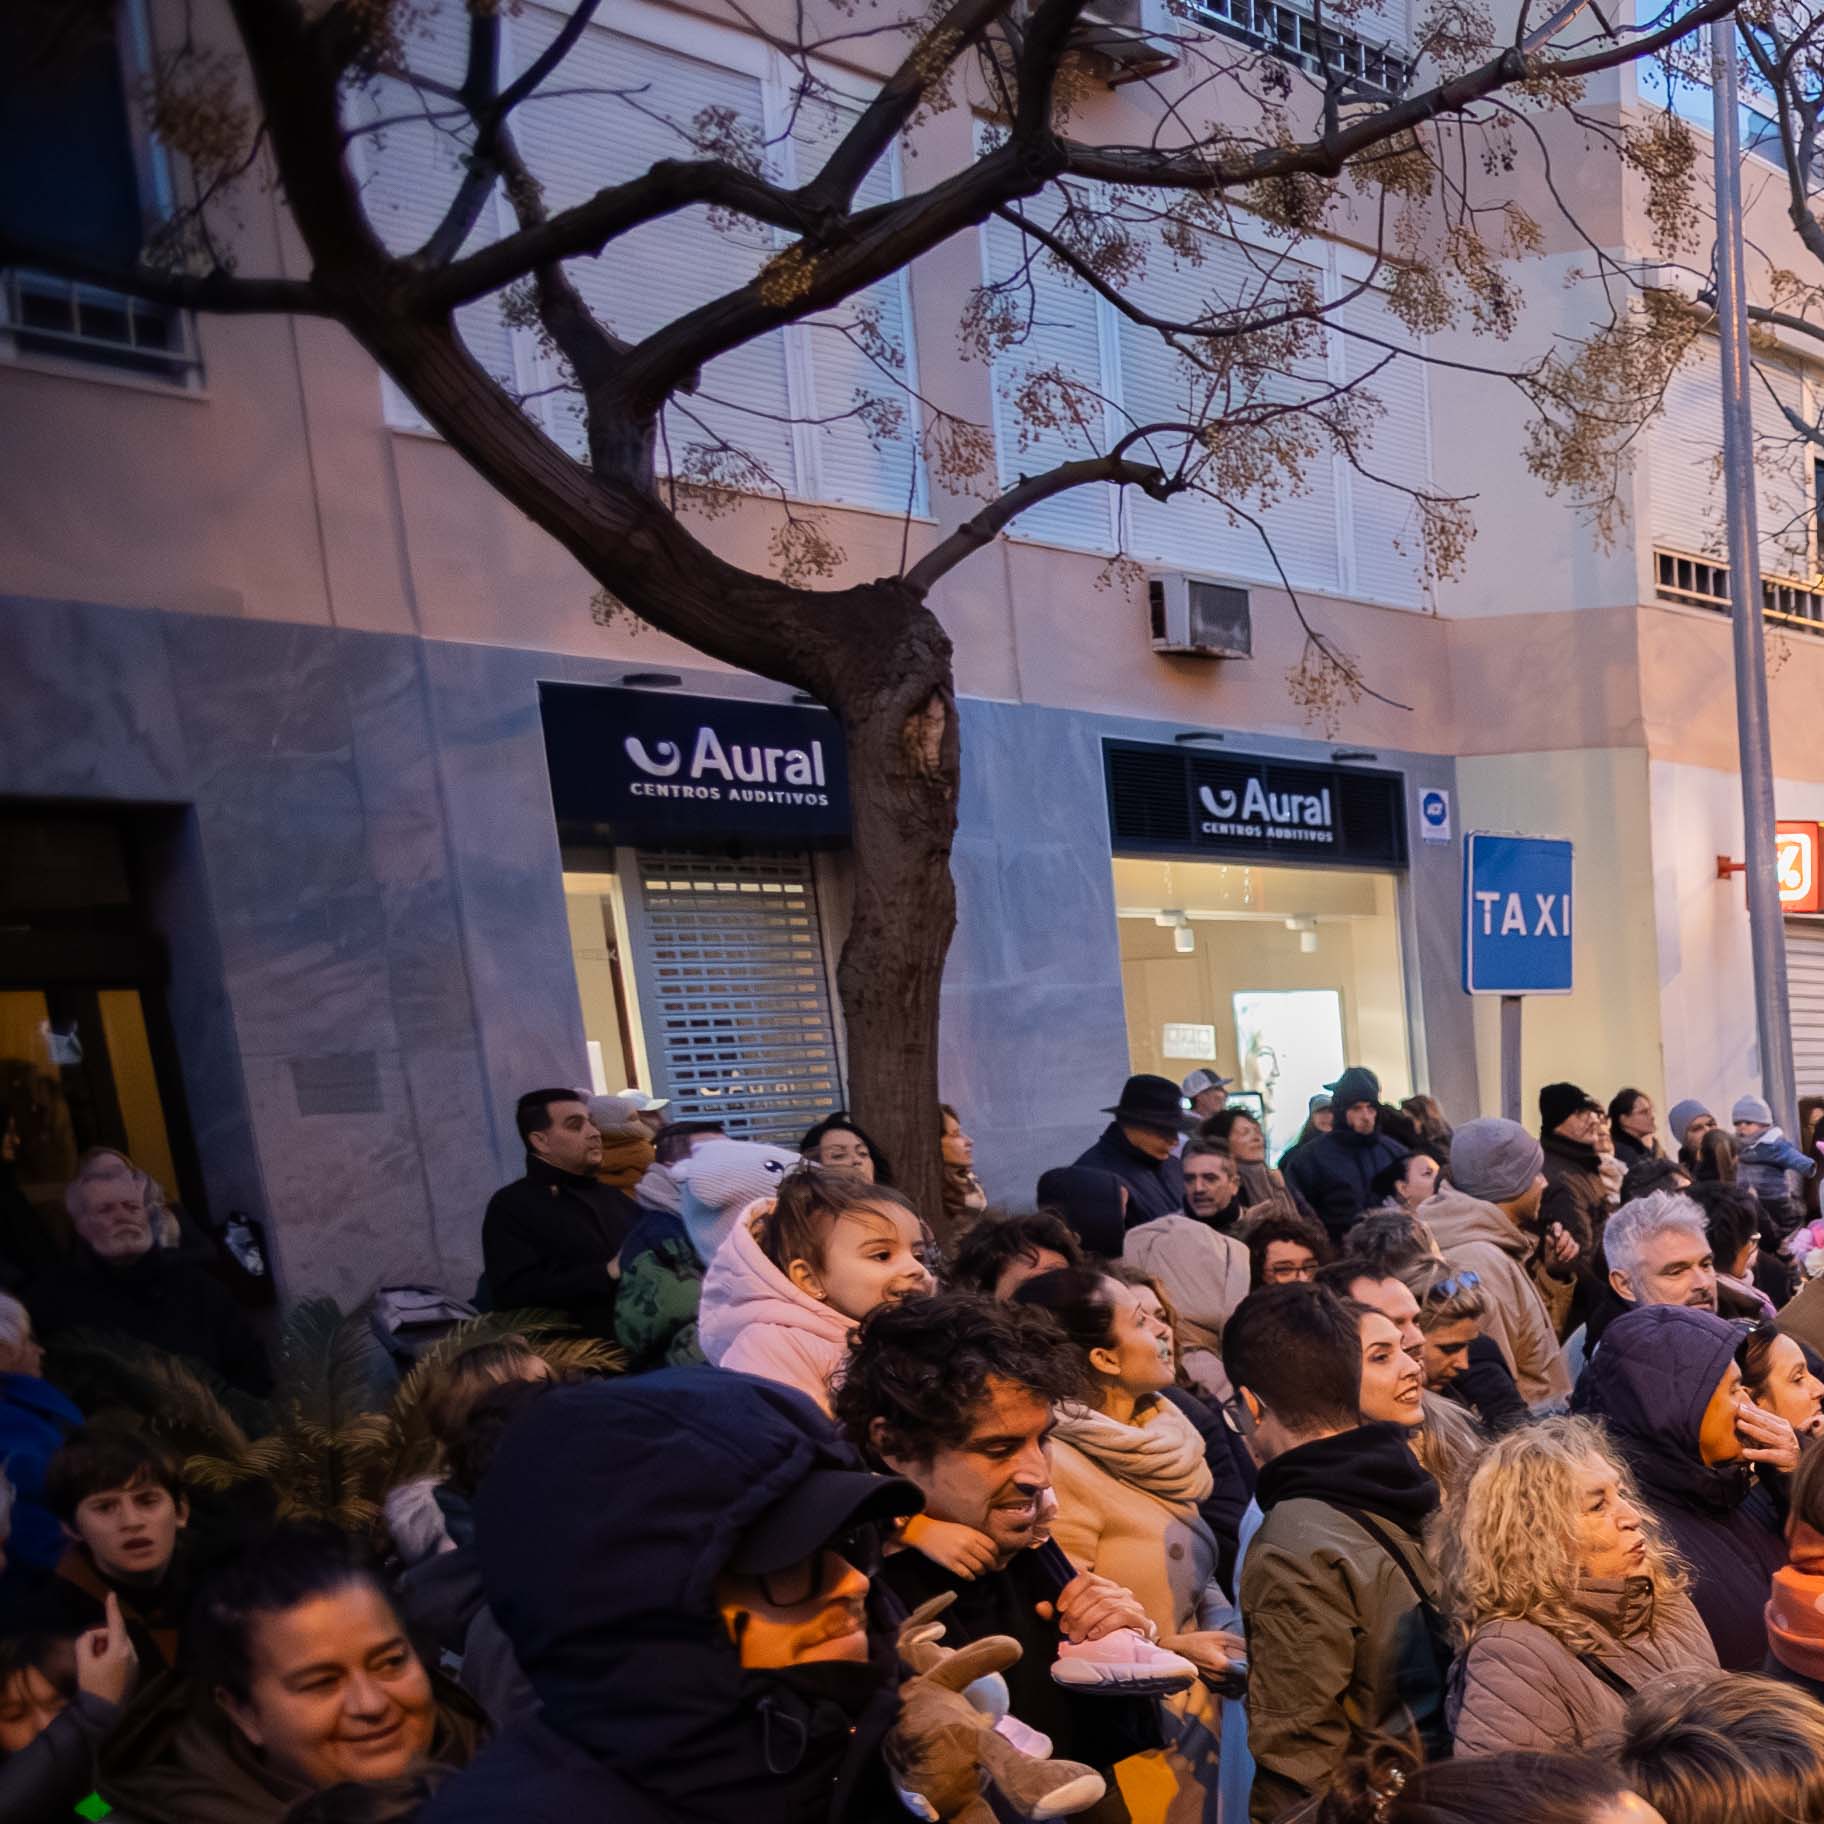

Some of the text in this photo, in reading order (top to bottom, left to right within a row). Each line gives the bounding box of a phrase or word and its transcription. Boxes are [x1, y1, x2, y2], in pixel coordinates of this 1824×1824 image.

[691, 726, 826, 786] Aural
[630, 782, 829, 806] CENTROS AUDITIVOS
[1242, 778, 1333, 826] Aural
[1202, 822, 1333, 843] CENTROS AUDITIVOS
[1475, 891, 1570, 936] TAXI
